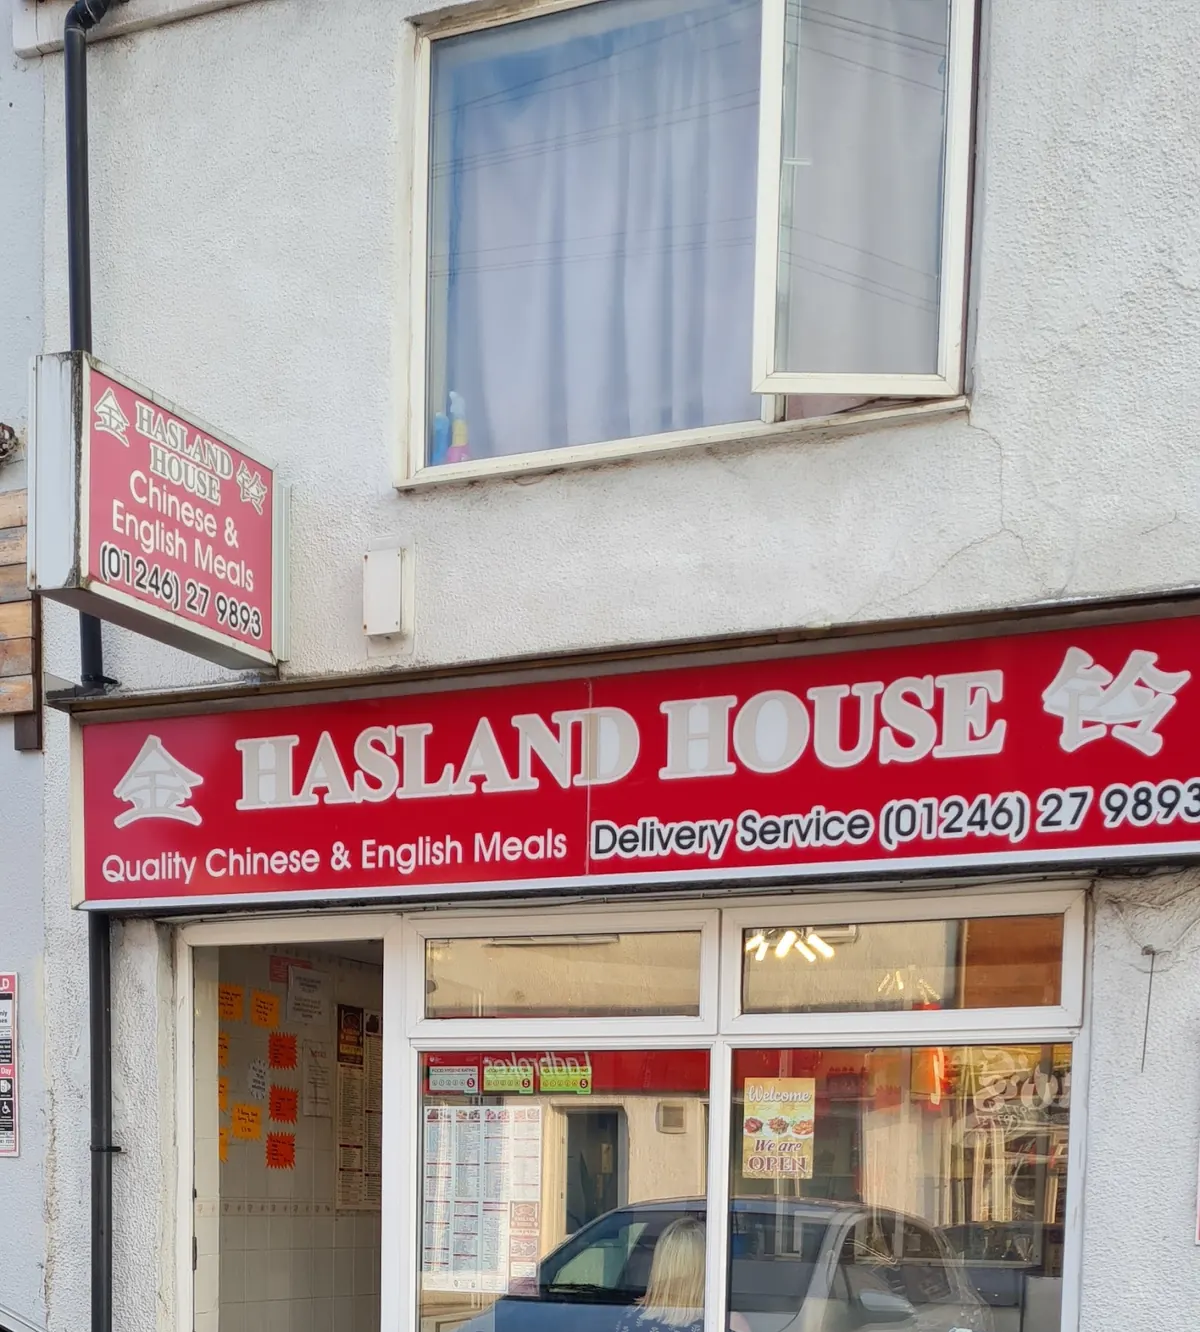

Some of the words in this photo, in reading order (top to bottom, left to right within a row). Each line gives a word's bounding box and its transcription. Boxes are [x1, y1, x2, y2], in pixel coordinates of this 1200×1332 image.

[136, 401, 233, 479] HASLAND
[150, 444, 221, 505] HOUSE
[112, 500, 187, 563] English
[194, 539, 254, 592] Meals
[130, 470, 216, 537] Chinese
[224, 517, 239, 548] &
[101, 542, 181, 611] (01246)
[186, 581, 209, 616] 27
[217, 595, 262, 639] 9893
[236, 707, 640, 810] HASLAND
[659, 669, 1007, 780] HOUSE
[103, 854, 196, 885] Quality
[206, 847, 320, 878] Chinese
[331, 843, 351, 870] &
[362, 836, 463, 875] English
[474, 828, 567, 863] Meals
[591, 818, 731, 860] Delivery
[737, 806, 873, 852] Service
[879, 791, 1030, 851] (01246)
[1037, 785, 1094, 832] 27
[1100, 776, 1200, 829] 9893
[748, 1085, 812, 1103] Welcome
[748, 1155, 807, 1173] OPEN
[755, 1140, 775, 1152] We
[778, 1141, 802, 1152] are
